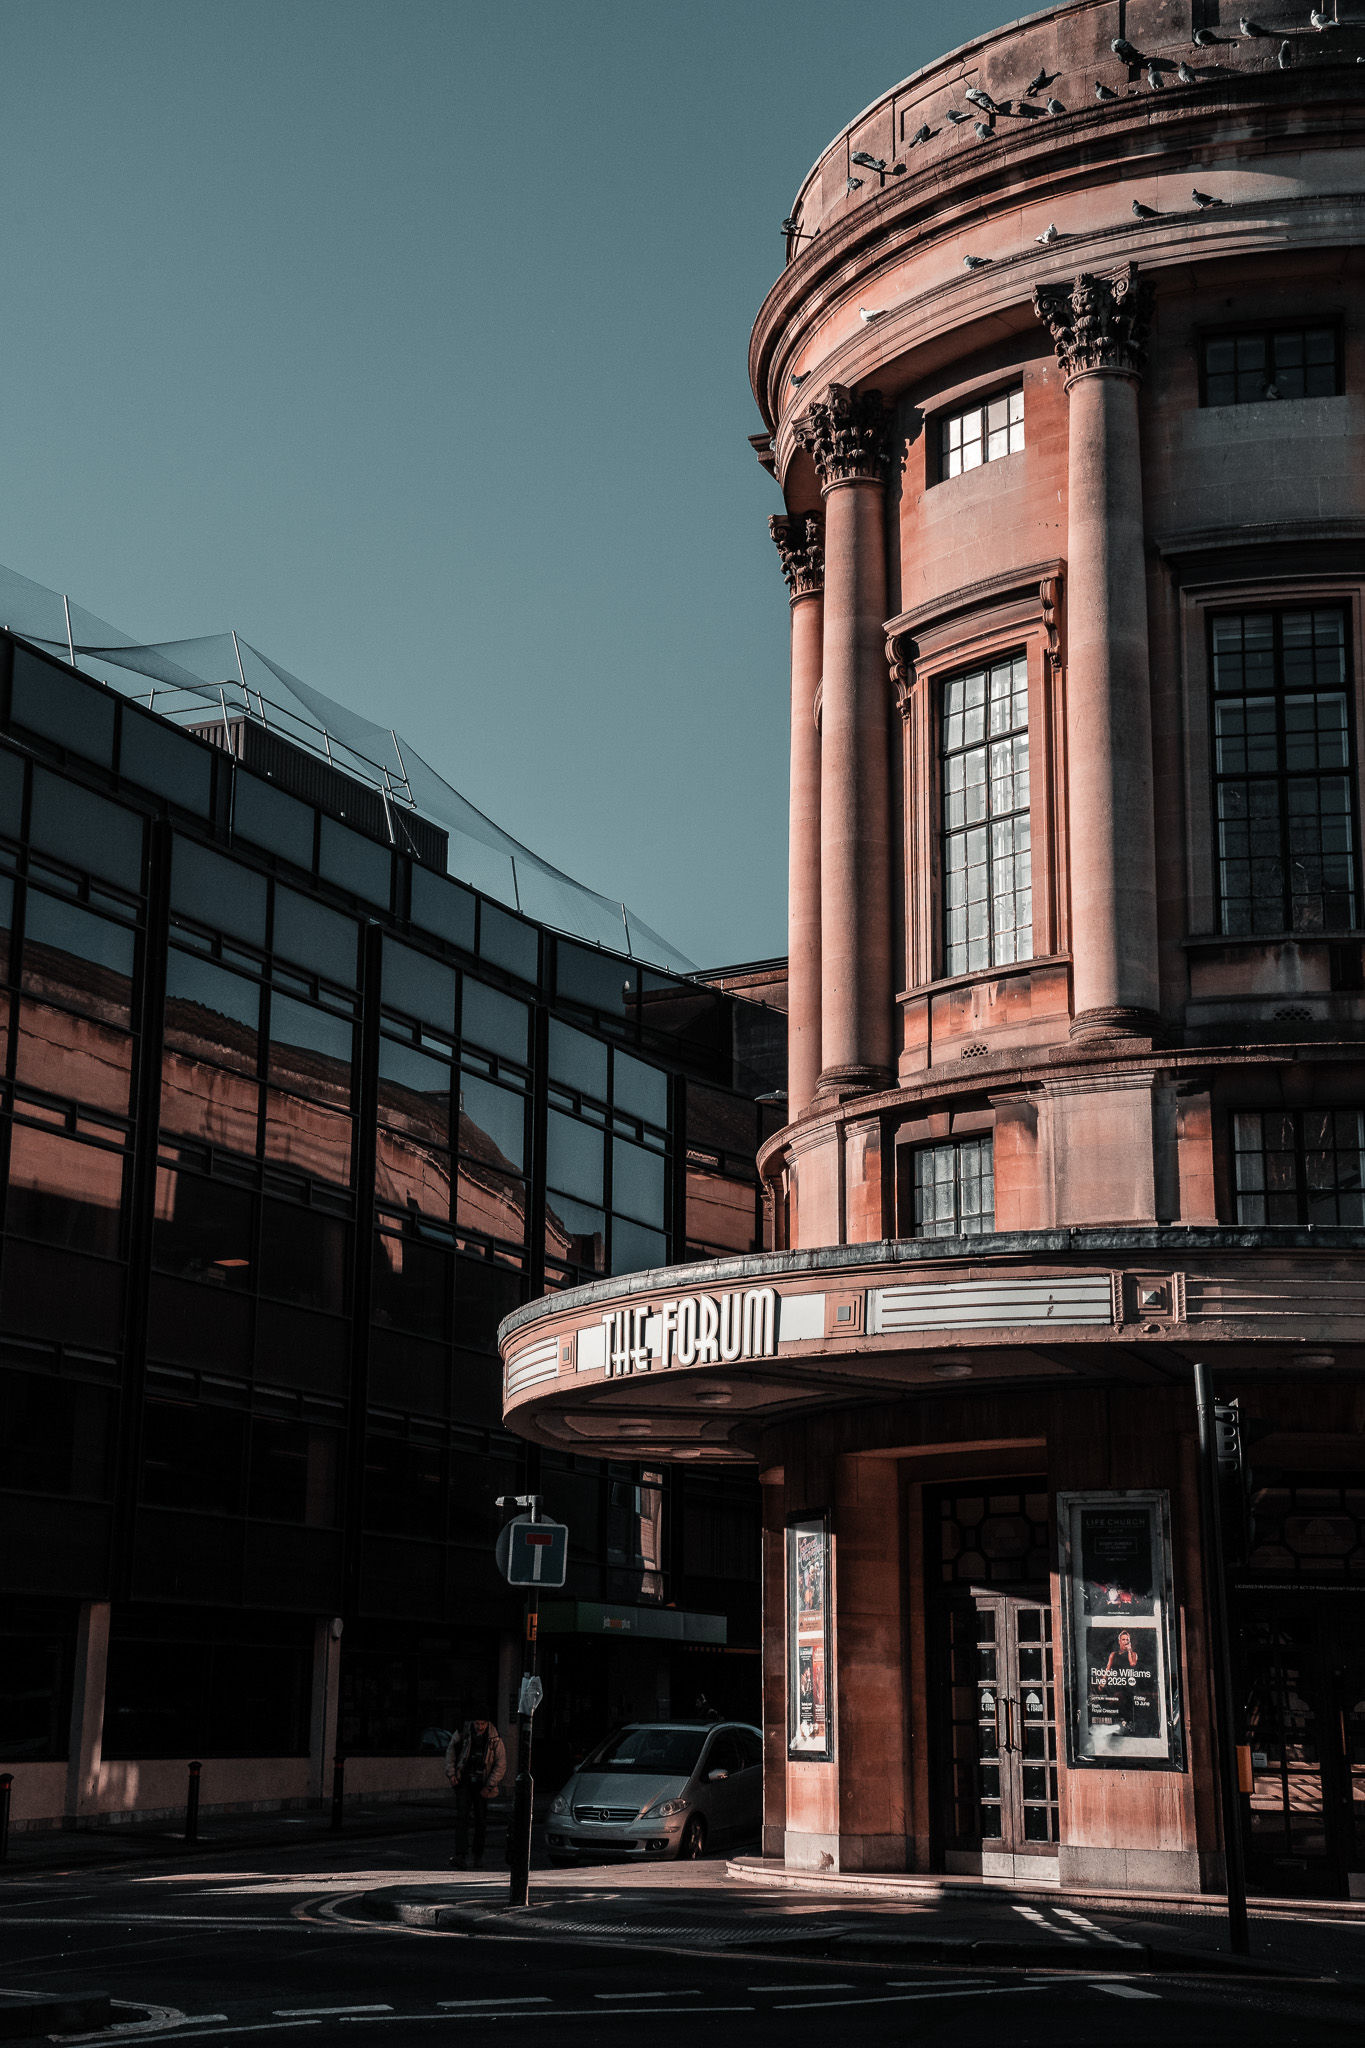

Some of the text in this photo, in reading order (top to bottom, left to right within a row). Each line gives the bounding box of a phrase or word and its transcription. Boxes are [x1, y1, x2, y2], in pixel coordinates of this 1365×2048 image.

[601, 1287, 777, 1378] THE FORUM
[1091, 1667, 1151, 1678] Robbie Williams
[1091, 1677, 1107, 1685] Live
[1107, 1677, 1127, 1686] 2025
